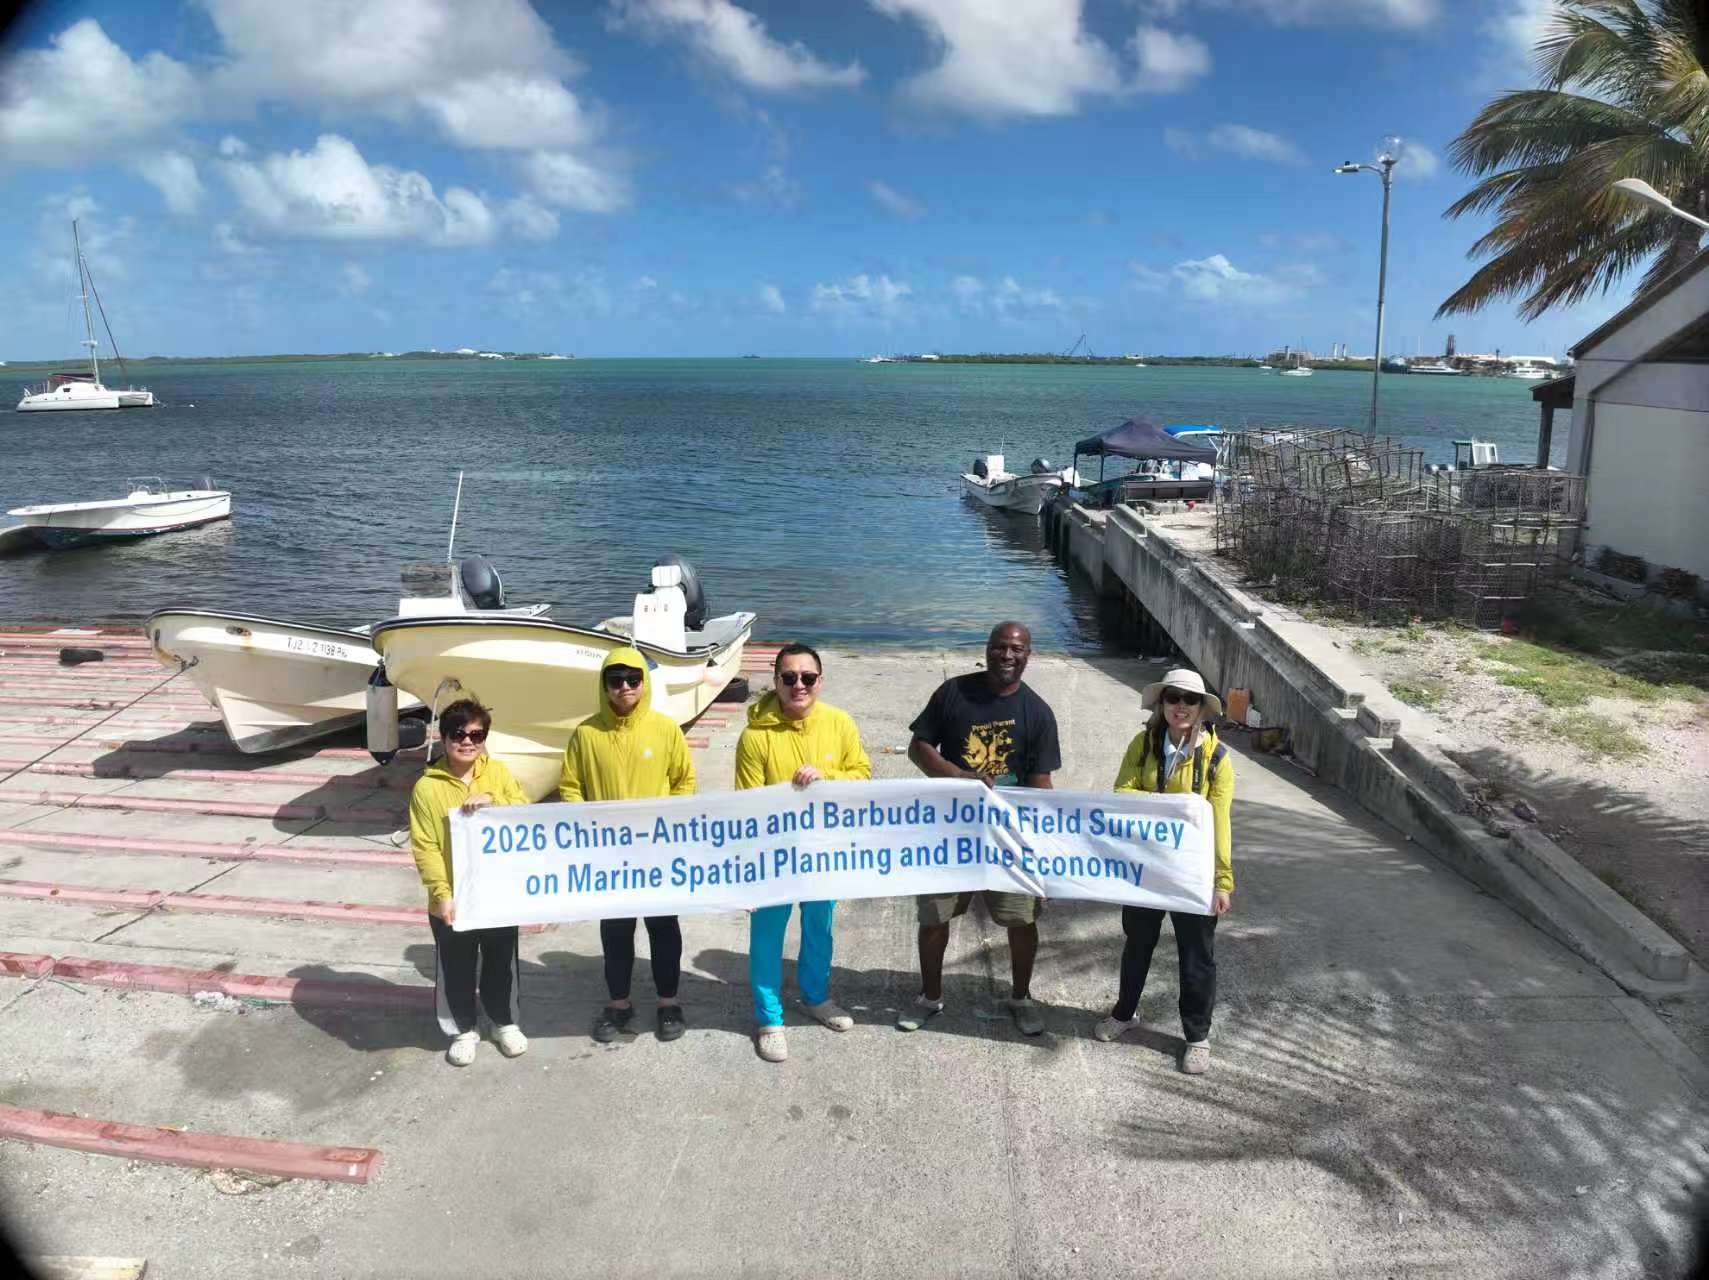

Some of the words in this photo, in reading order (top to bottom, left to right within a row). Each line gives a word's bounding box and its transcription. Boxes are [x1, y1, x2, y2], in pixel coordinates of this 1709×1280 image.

[482, 824, 548, 854] 2026
[766, 802, 815, 834] and
[822, 799, 937, 829] Barbuda
[943, 797, 1011, 828] Joint
[1017, 805, 1082, 834] Field
[1088, 808, 1185, 850] Survey
[526, 874, 559, 896] on
[567, 860, 663, 894] Marine
[670, 851, 766, 893] Spatial
[773, 842, 892, 878] Planning
[899, 838, 949, 867] and
[956, 837, 1015, 868] Blue
[1020, 846, 1145, 887] Economy
